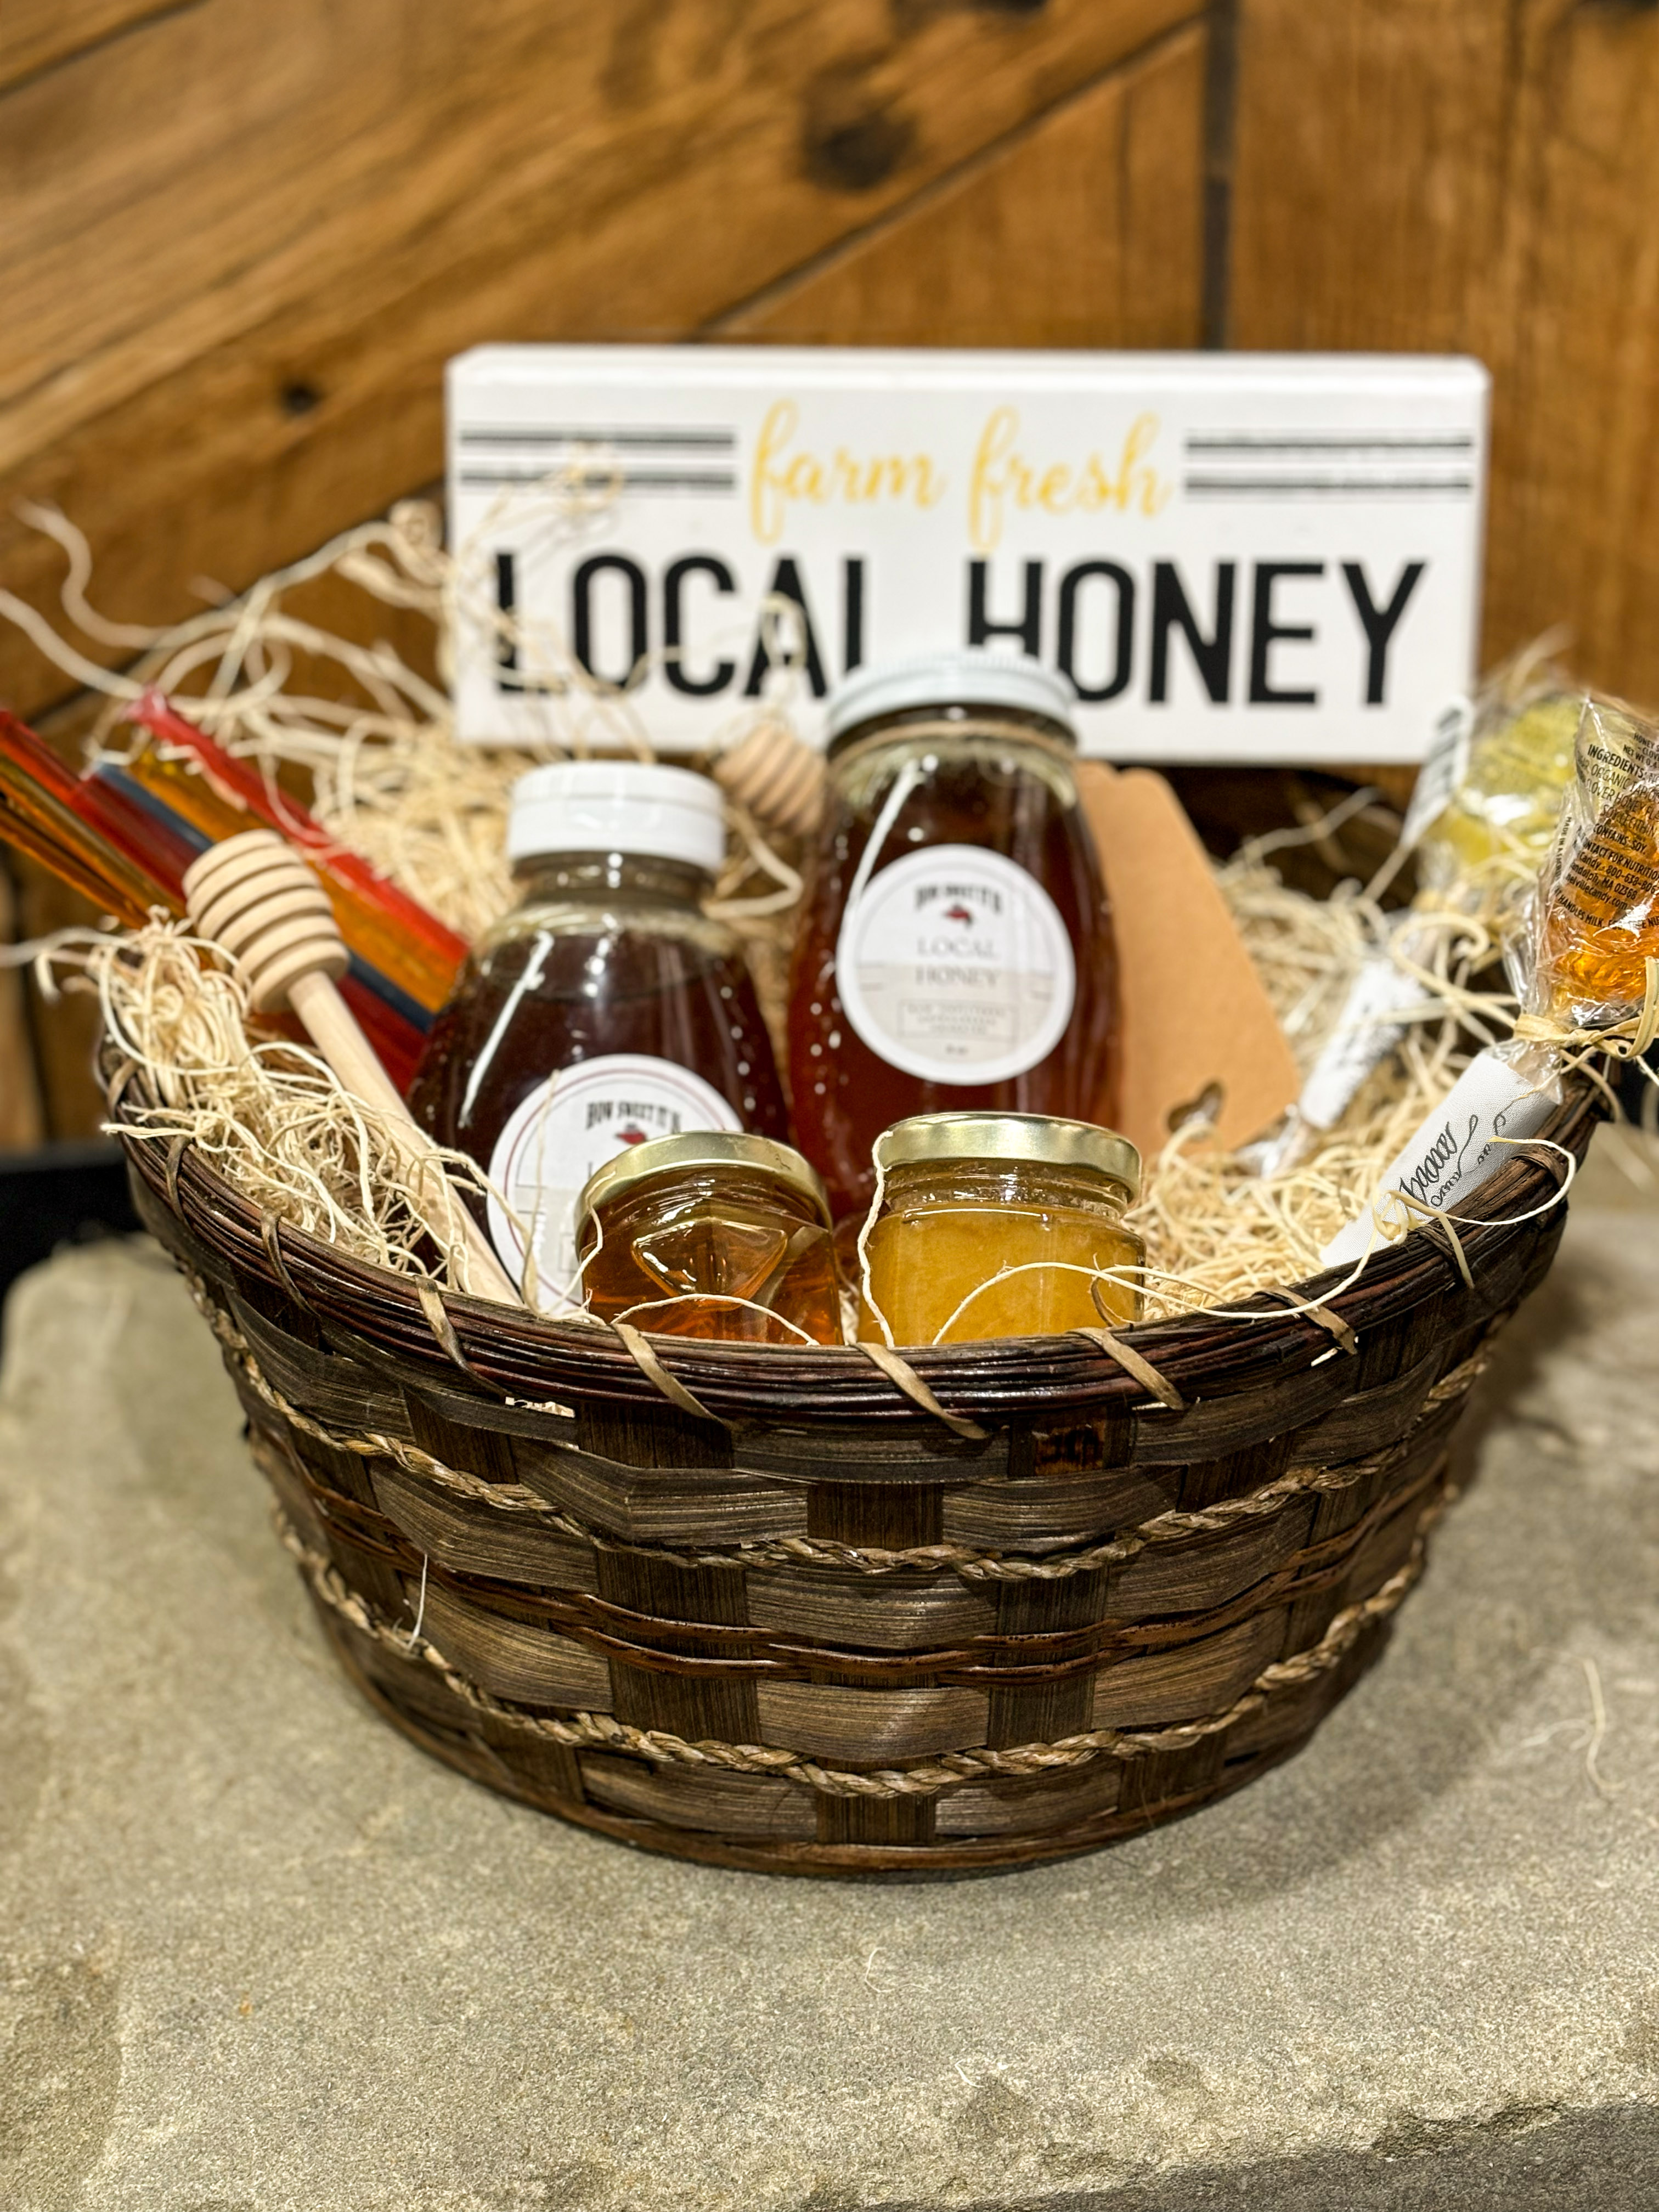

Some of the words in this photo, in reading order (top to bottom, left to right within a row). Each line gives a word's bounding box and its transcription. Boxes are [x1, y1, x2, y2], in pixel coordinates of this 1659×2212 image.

[749, 398, 947, 545] farm
[967, 405, 1173, 556] fresh
[967, 558, 1430, 706] HONEY
[1591, 764, 1630, 790] ORGANIC
[1571, 862, 1599, 885] andolph,
[1605, 865, 1659, 894] 800-638-806
